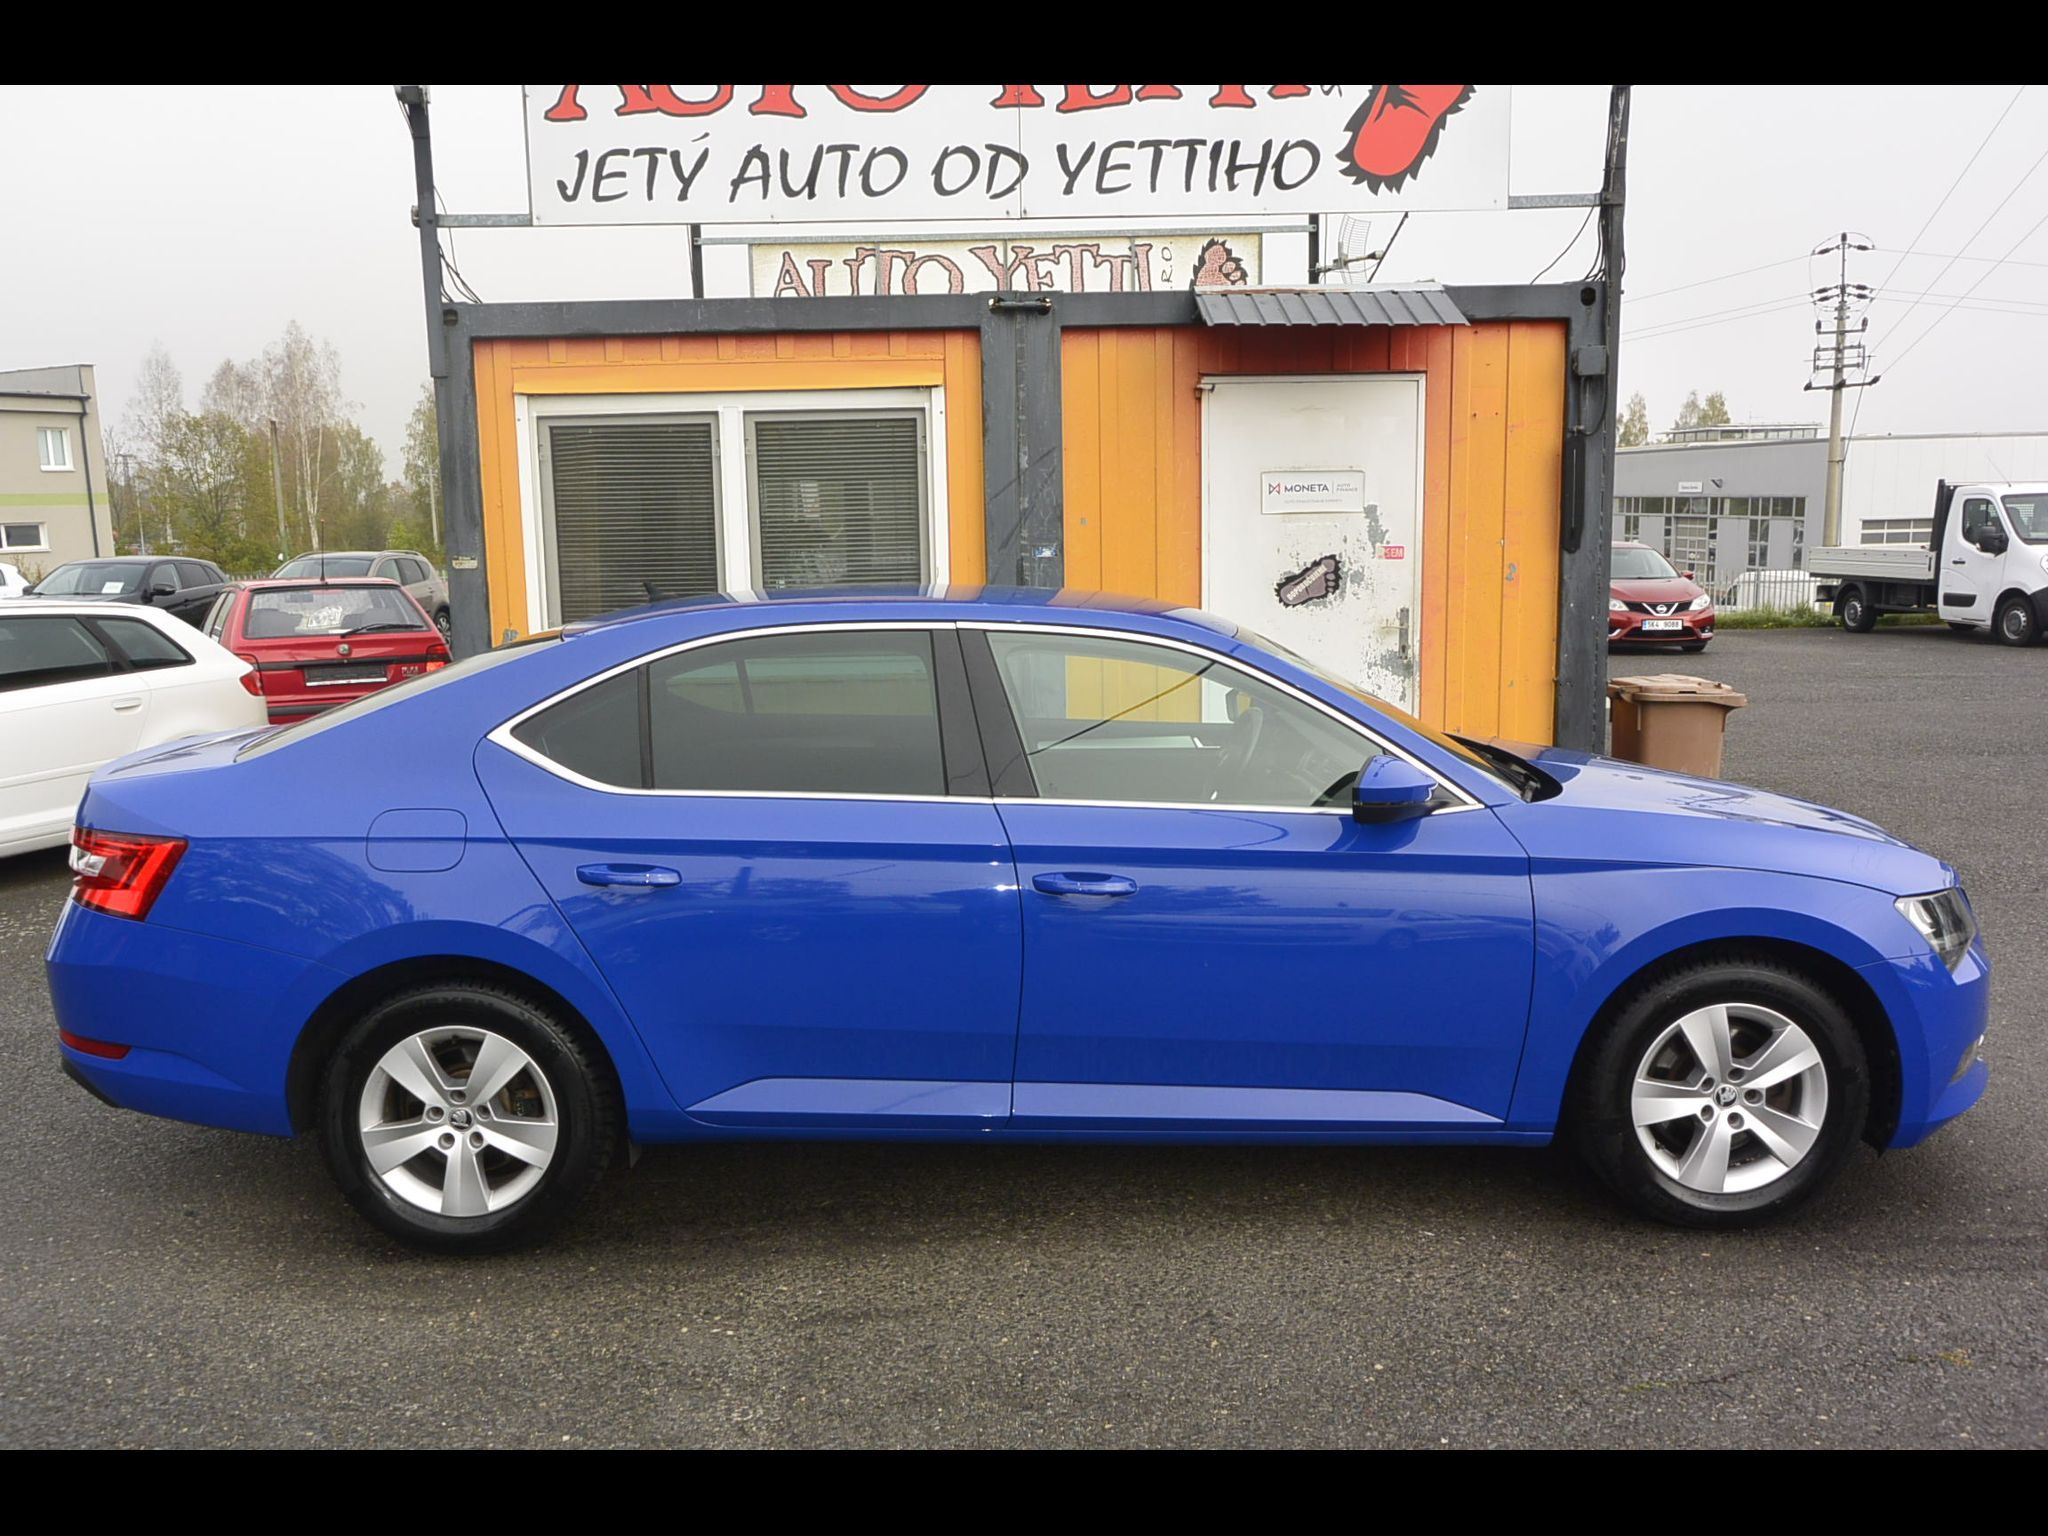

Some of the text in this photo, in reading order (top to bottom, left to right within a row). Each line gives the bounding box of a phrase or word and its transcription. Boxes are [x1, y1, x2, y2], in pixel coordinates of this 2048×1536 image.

[556, 132, 1321, 203] JETÝ AUTO OD YETTIHO
[1284, 483, 1329, 493] MONETA
